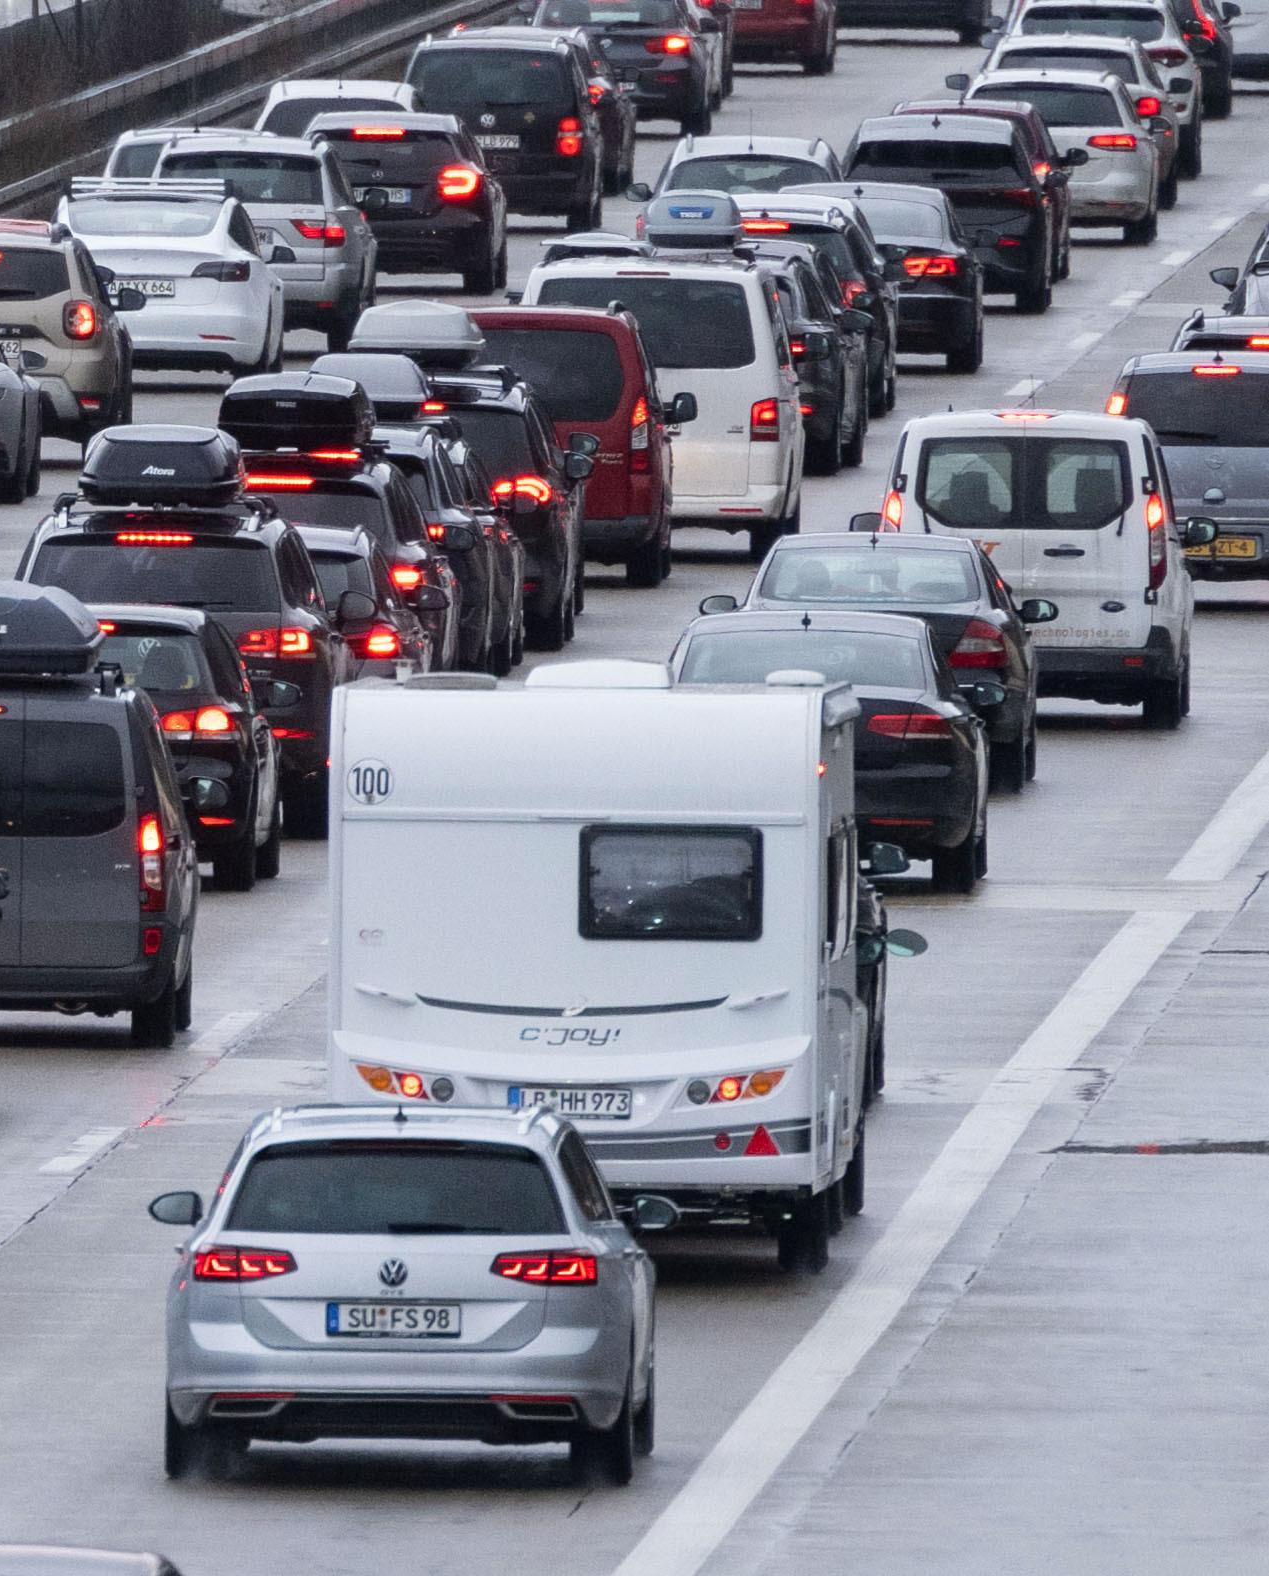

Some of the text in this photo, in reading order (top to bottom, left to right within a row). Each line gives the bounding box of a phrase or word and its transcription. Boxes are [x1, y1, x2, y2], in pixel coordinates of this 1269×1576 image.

[152, 281, 172, 293] 664
[352, 767, 389, 796] 100
[560, 1091, 587, 1111] HH
[591, 1092, 630, 1112] 973
[348, 1308, 450, 1329] SU FS 98
